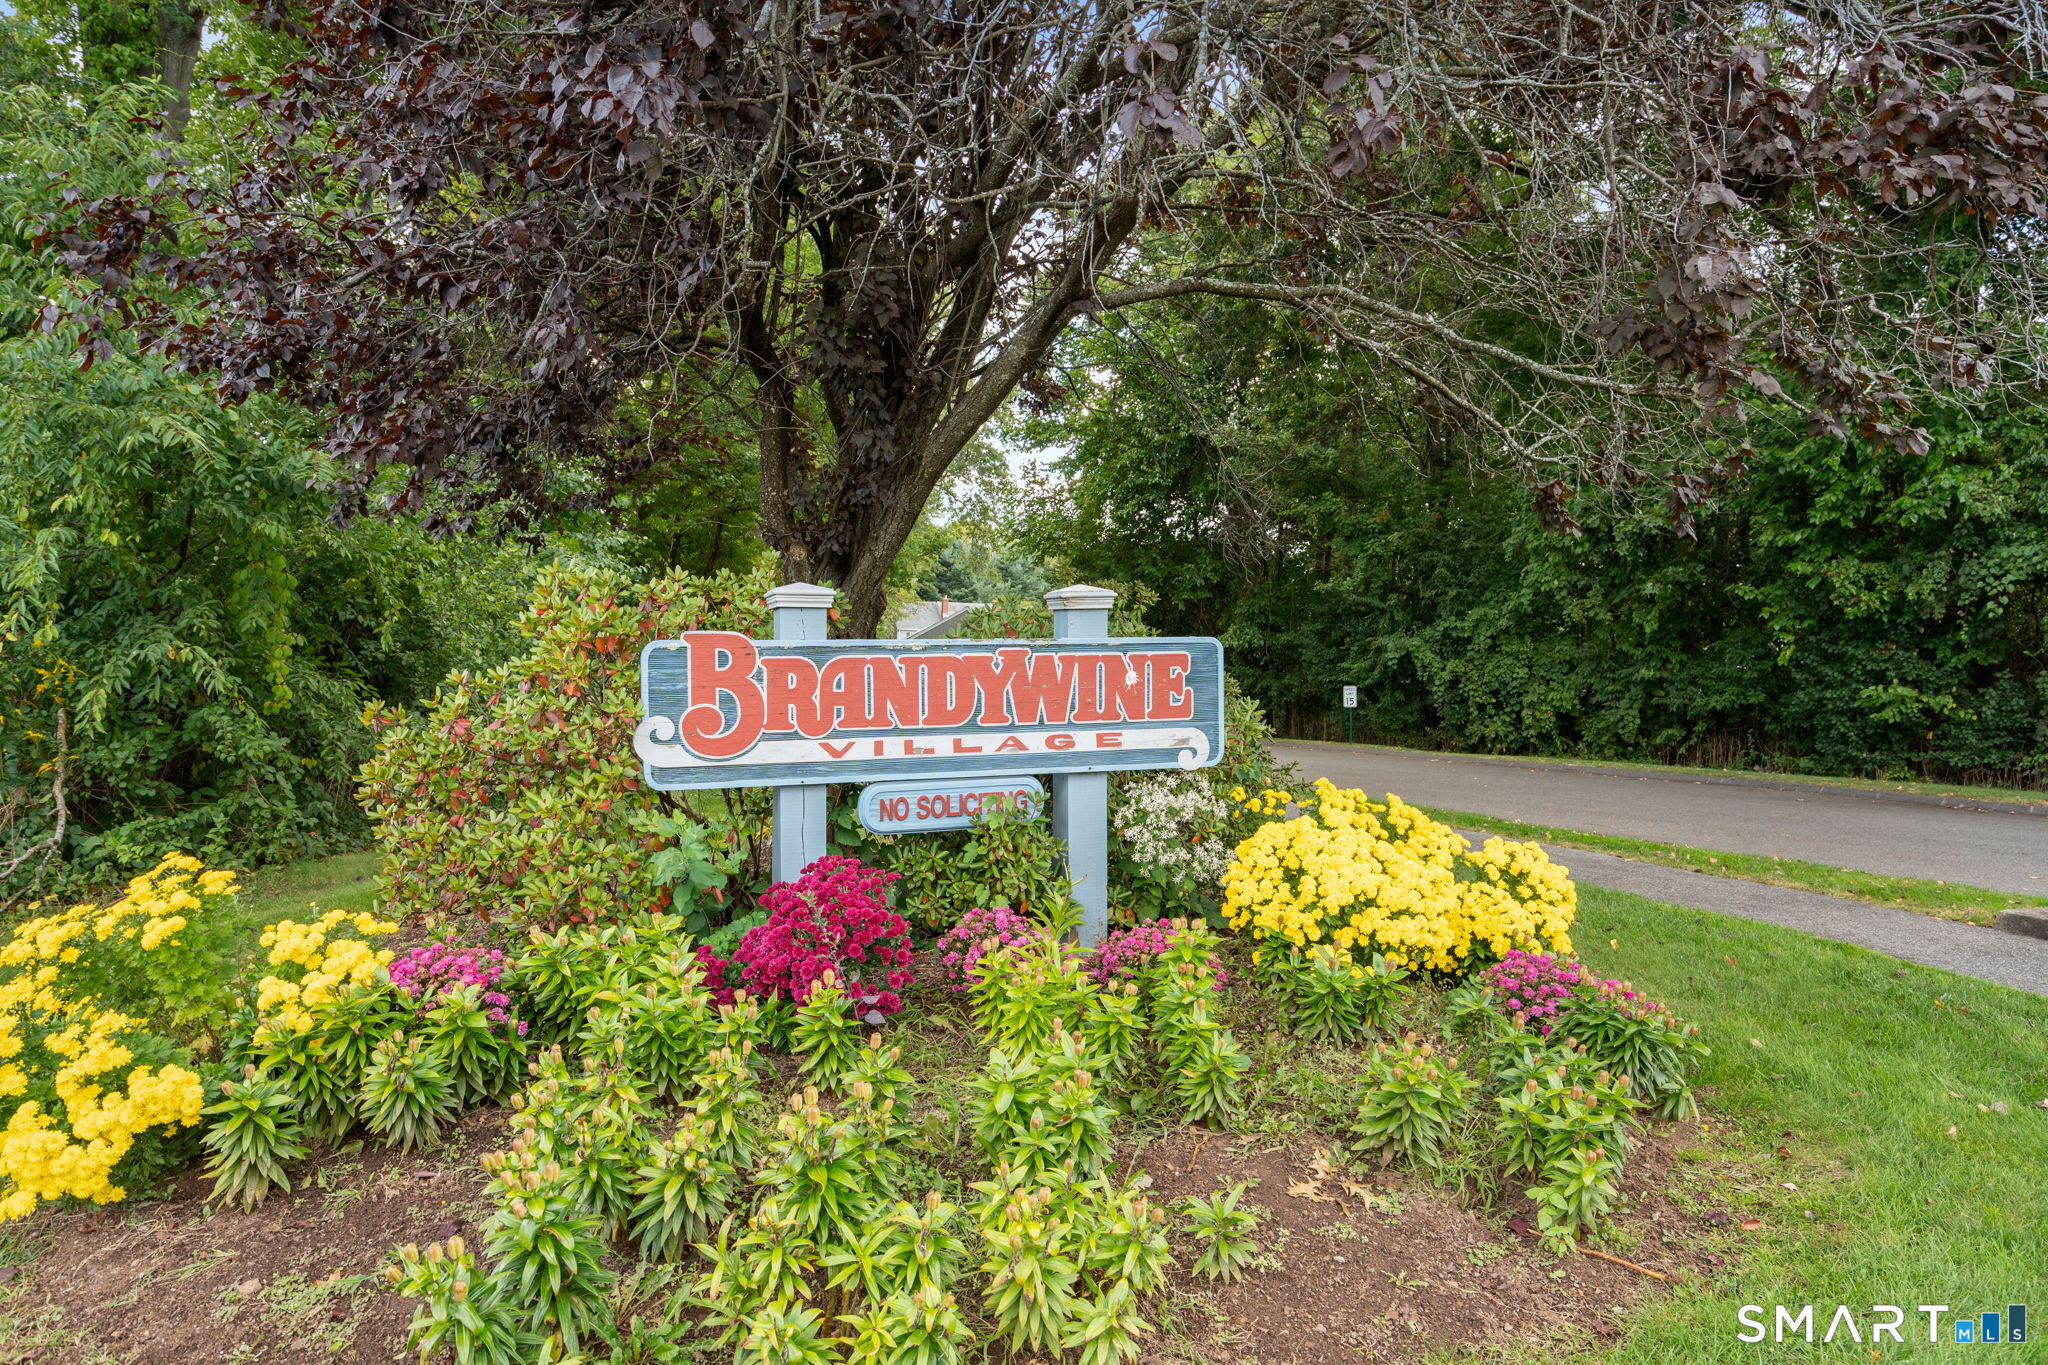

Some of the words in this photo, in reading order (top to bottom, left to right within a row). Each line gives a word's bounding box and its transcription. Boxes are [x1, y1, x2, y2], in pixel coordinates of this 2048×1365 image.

[680, 632, 1193, 757] BRANDYWINE
[1346, 697, 1355, 705] 15
[818, 732, 1122, 758] VILLAGE
[879, 796, 909, 821] NO
